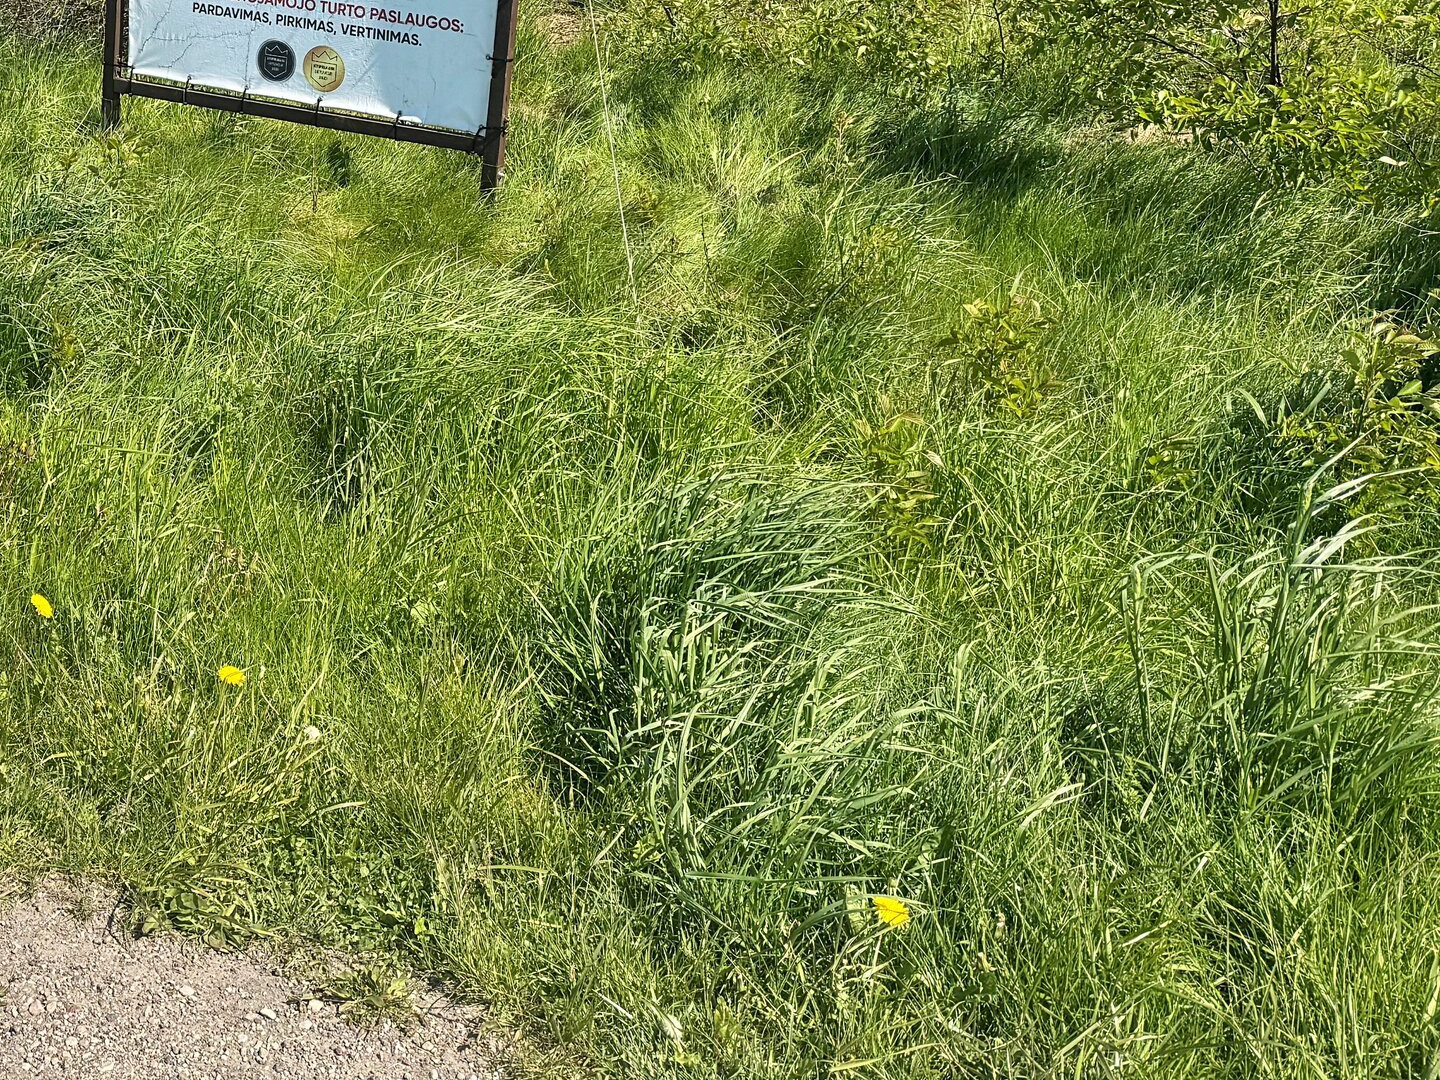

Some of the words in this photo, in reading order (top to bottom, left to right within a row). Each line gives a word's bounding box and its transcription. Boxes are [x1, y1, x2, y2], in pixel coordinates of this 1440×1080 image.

[192, 1, 273, 26] PARDAVIMAS,
[275, 13, 338, 37] PIRKIMAS,
[340, 23, 423, 47] VERTINIMAS.
[319, 0, 366, 19] TURTO
[369, 7, 465, 34] PASLAUGOS:
